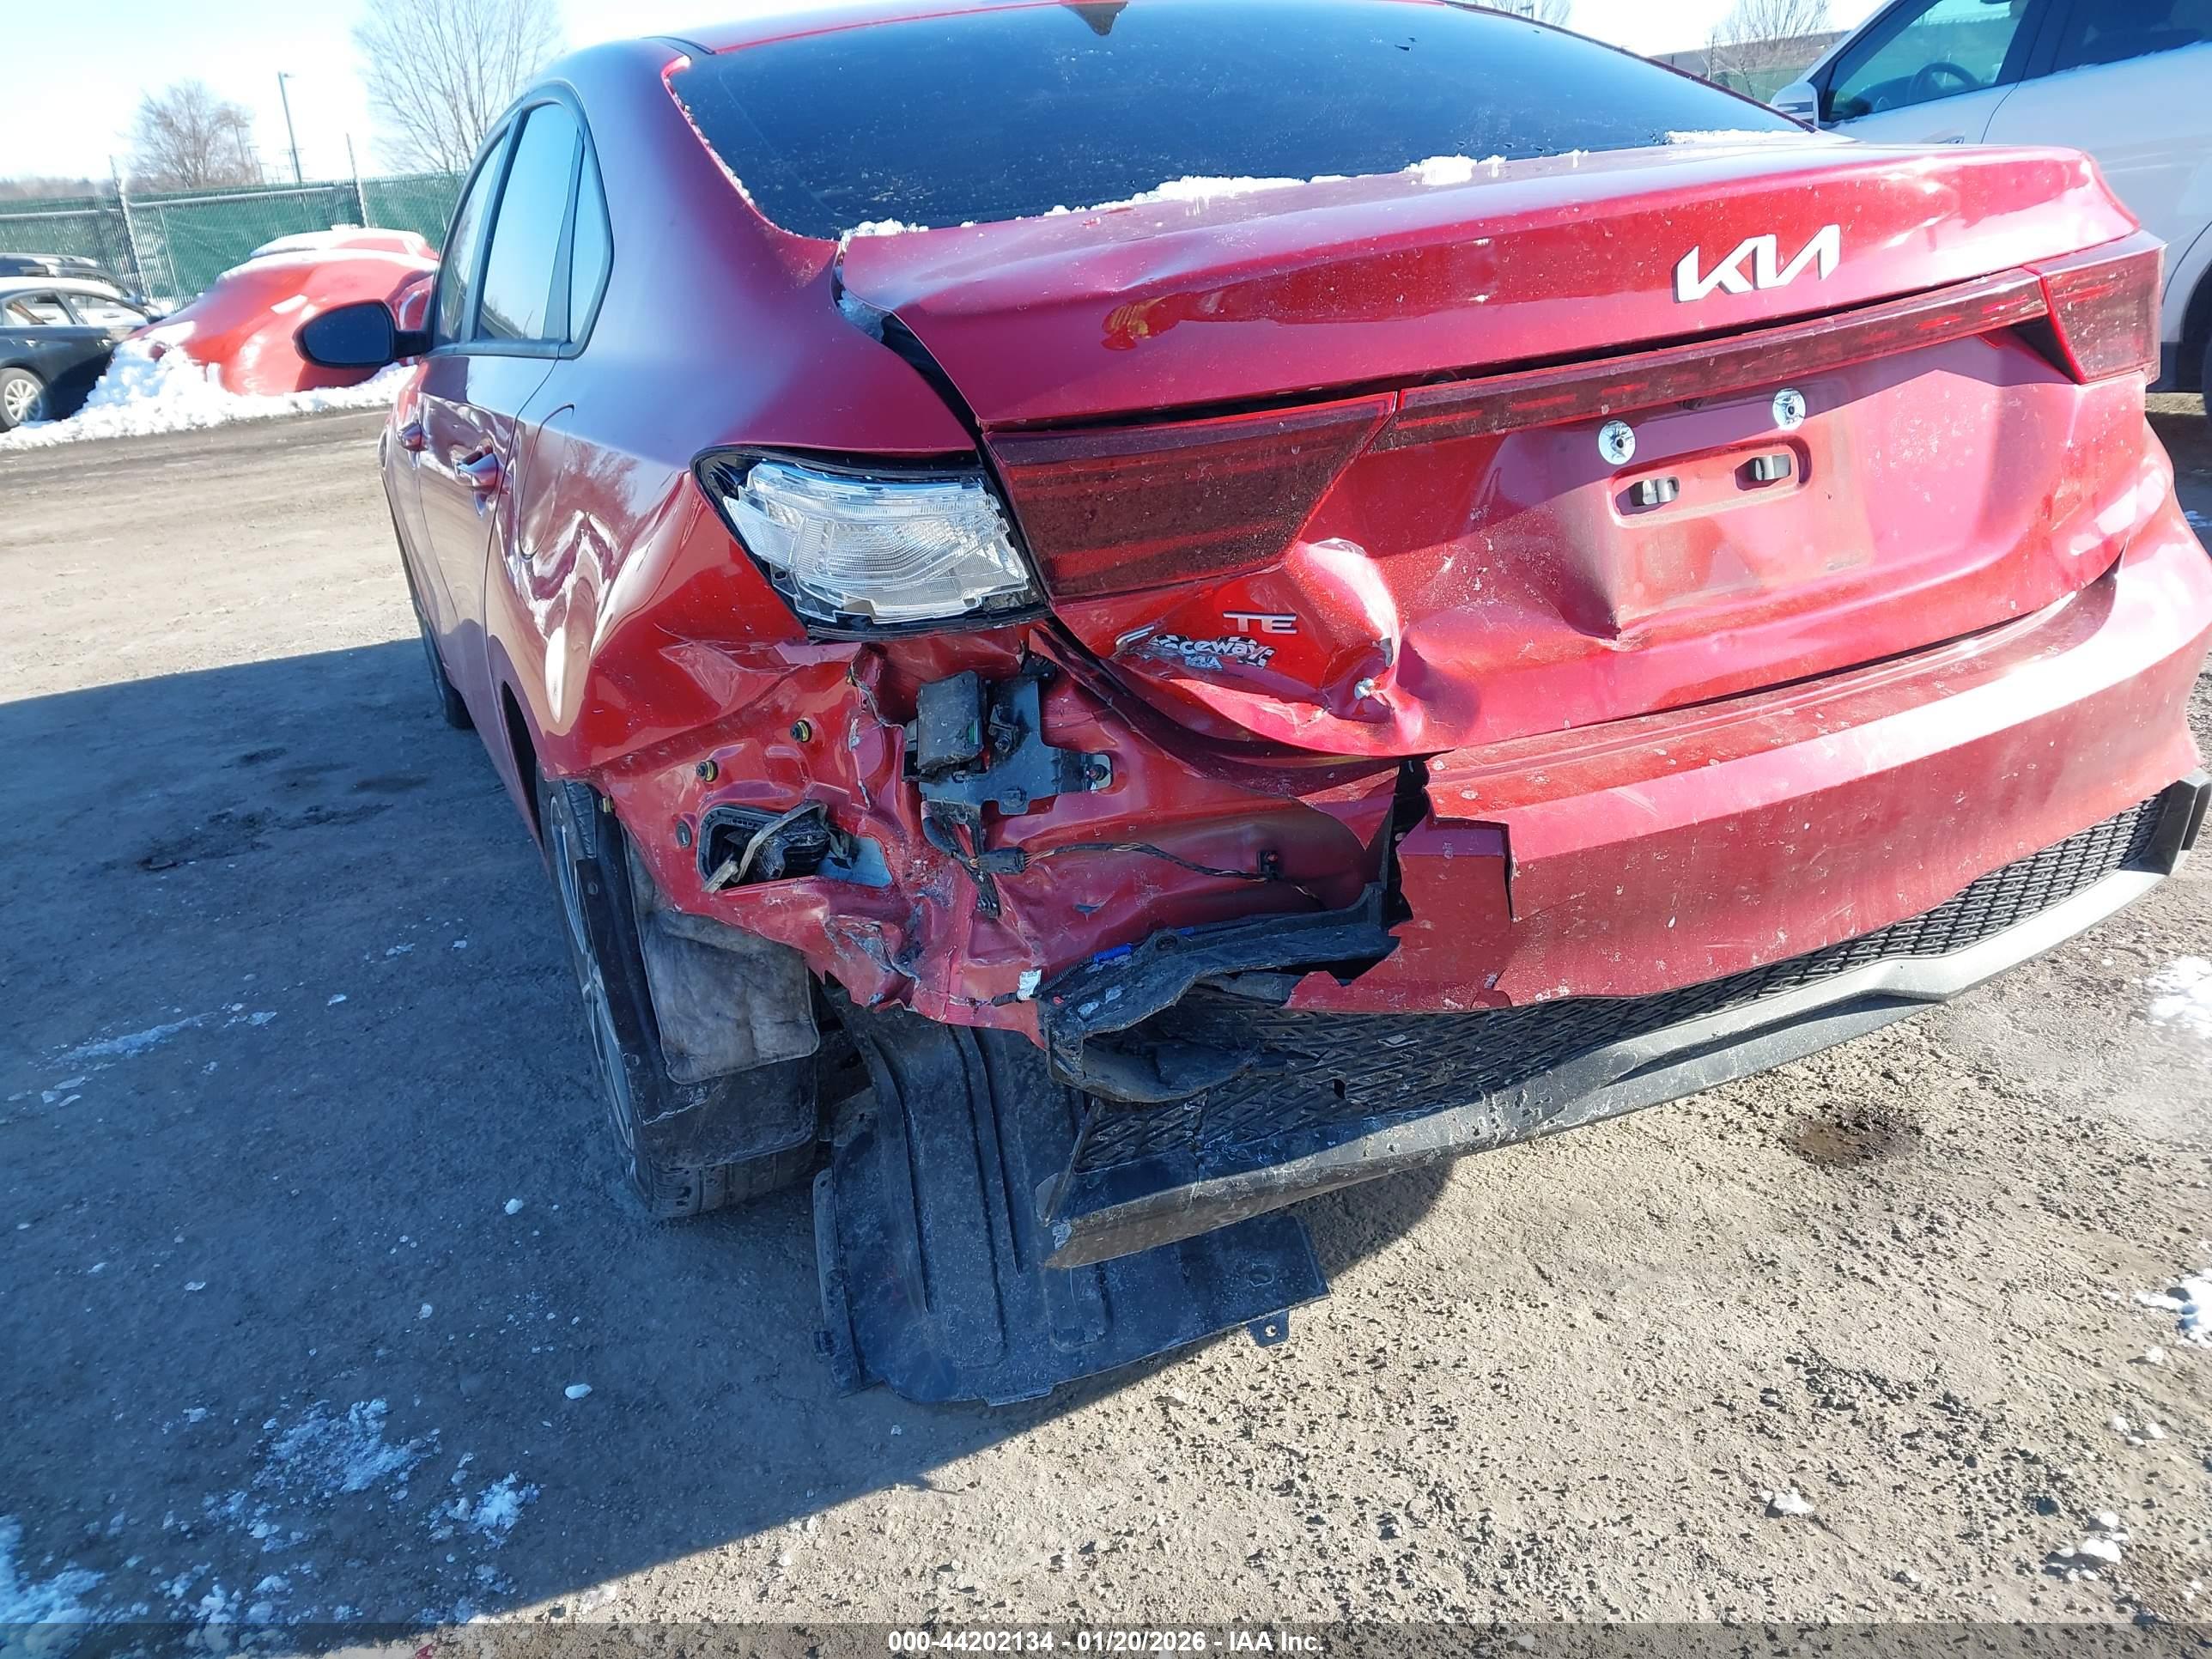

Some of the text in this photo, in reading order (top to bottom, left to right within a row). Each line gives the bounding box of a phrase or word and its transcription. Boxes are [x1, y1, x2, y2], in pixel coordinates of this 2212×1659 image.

[1672, 223, 1841, 303] KIA
[1223, 611, 1297, 635] TE
[1159, 639, 1273, 660] ceway
